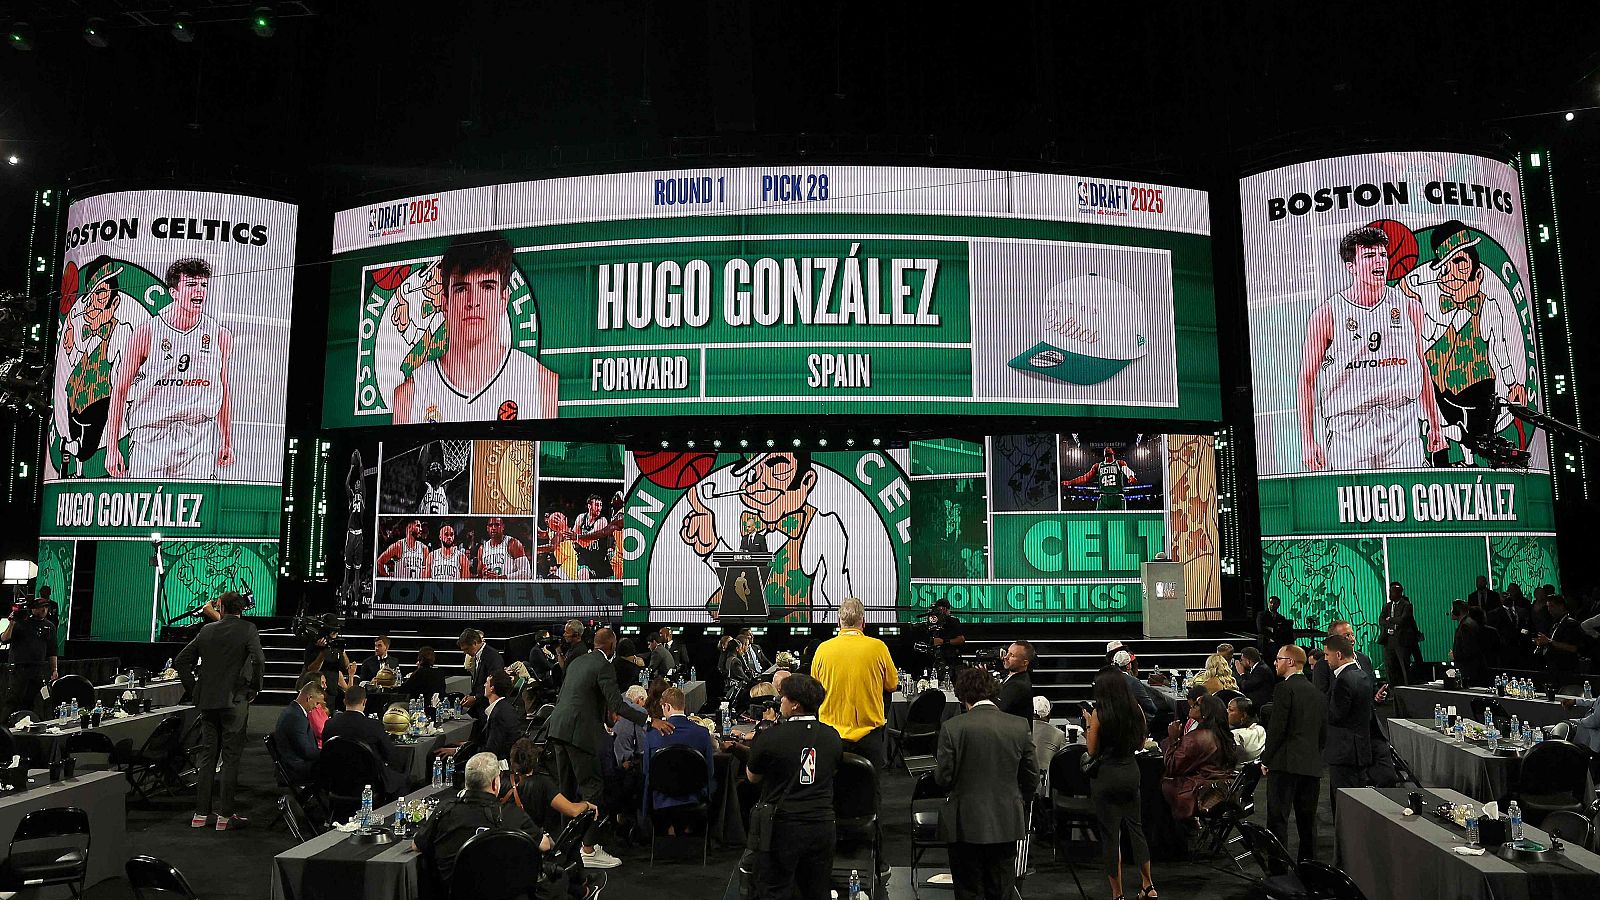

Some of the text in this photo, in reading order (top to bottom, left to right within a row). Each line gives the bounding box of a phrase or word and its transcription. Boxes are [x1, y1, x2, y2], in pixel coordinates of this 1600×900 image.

[654, 176, 725, 206] ROUND 1
[762, 174, 829, 202] PICK 28
[1090, 182, 1164, 214] DRAFT 2025
[1267, 180, 1514, 222] BOSTON CELTICS
[378, 198, 439, 231] DRAFT 2025
[151, 217, 268, 246] CELTICS
[597, 241, 940, 331] HUGO GONZÁLEZ
[1368, 331, 1382, 352] 9
[178, 353, 190, 372] 9
[591, 355, 688, 392] FORWARD
[807, 353, 871, 388] SPAIN
[1344, 357, 1408, 370] AUTOHERO
[154, 378, 210, 387] AUTOHERO
[1101, 475, 1117, 487] 42
[56, 486, 204, 528] HUGO GONZÁLEZ
[1337, 475, 1518, 524] HUGO GONZÁLEZ
[1006, 584, 1128, 610] CELTICS
